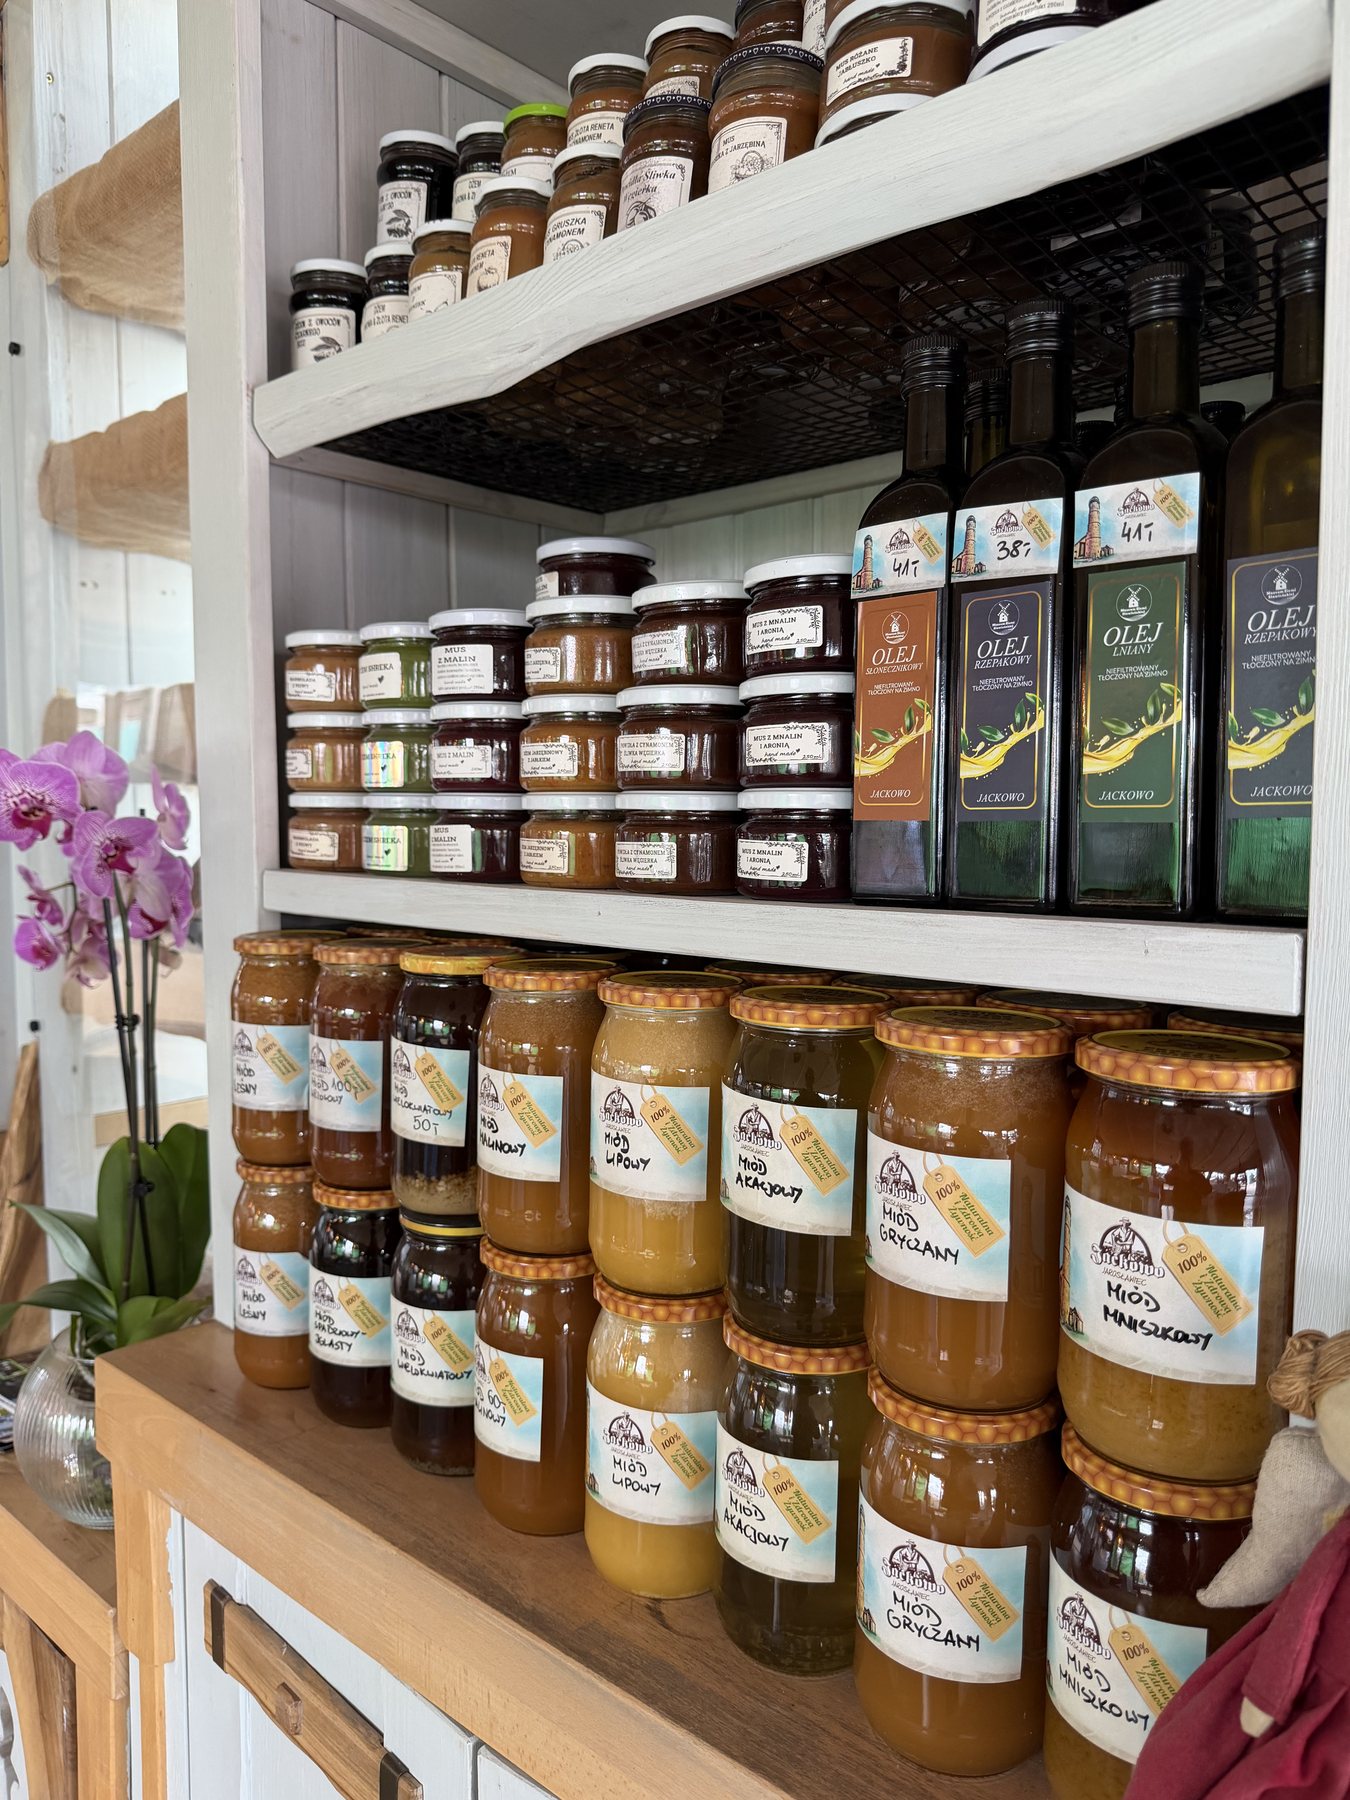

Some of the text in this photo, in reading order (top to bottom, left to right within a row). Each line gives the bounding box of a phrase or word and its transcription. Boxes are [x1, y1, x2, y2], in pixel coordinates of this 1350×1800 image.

[836, 47, 879, 71] MUS RÓŻANE
[837, 56, 876, 78] JABŁUSZKO
[590, 122, 614, 131] RENETA
[723, 136, 735, 147] MUS
[729, 140, 766, 155] JARZĘBINĄ
[644, 168, 676, 183] Śliwka
[552, 217, 587, 232] GRUSZKA
[752, 621, 763, 629] MUS
[768, 617, 797, 626] MNALIN
[1247, 604, 1317, 632] OLEJ
[760, 627, 785, 636] ARONIĄ
[1103, 622, 1164, 647] OLEJ
[1243, 626, 1318, 645] RZEPAKOWY
[444, 646, 466, 654] MUS
[871, 644, 918, 666] OLEJ
[977, 636, 1029, 659] OLEJ
[1112, 643, 1154, 657] LNIANY
[1251, 649, 1312, 663] NIEFILTROWANY
[443, 656, 476, 664] MALIN
[865, 662, 924, 676] SŁONECZNIKOWY
[974, 655, 1033, 670] RZEPAKOWY
[1106, 664, 1159, 675] NIEFILTROWANY
[1242, 656, 1316, 670] TŁOCZONY NA ZIMN
[873, 681, 914, 690] NIEFILTROWANY
[972, 683, 1003, 692] TŁOCZONY
[1012, 680, 1034, 688] ZIMNO
[979, 675, 1026, 686] NIEFILTROWANY
[1097, 669, 1168, 682] TŁOCZONY NA ZIMNO
[867, 688, 895, 696] TŁOCZONY
[870, 789, 912, 799] JACKOWO
[976, 792, 1025, 803] JACKOWO
[1098, 790, 1154, 801] JACKOWO
[1250, 785, 1313, 798] JACKOWO
[749, 857, 772, 865] ARONIĄ
[510, 1093, 527, 1108] 100%
[650, 1105, 671, 1123] 100%
[605, 1131, 630, 1154] MIÓD
[669, 1114, 696, 1149] Naturalna
[733, 1125, 782, 1151] Jackowo
[790, 1127, 813, 1147] 100%
[606, 1150, 651, 1171] LIPOWY
[738, 1153, 767, 1176] MIÓD
[810, 1149, 832, 1179] Zdrowa
[811, 1138, 841, 1176] Naturalna
[736, 1172, 803, 1203] AKACJOWY
[875, 1175, 926, 1205] Jackowo
[935, 1180, 960, 1201] 100%
[883, 1202, 919, 1232] MIÓD
[948, 1206, 979, 1241] Żywność
[958, 1203, 984, 1238] Zdrowa
[960, 1191, 994, 1235] Naturalna
[879, 1223, 959, 1265] GRYCZANY
[1090, 1242, 1165, 1279] Jackowo
[1176, 1250, 1208, 1274] 100%
[242, 1289, 266, 1302] MIÓD
[1107, 1280, 1161, 1313] MIÓD
[1203, 1277, 1232, 1314] Zdrowa
[1207, 1264, 1242, 1312] Naturalna
[1192, 1280, 1223, 1319] Żywność
[239, 1304, 266, 1321] LEŚNY
[431, 1326, 447, 1340] 100%
[1103, 1304, 1213, 1351] MNISZKOWY
[400, 1345, 425, 1366] MIÓD
[495, 1370, 509, 1383] 100%
[661, 1432, 681, 1450] 100%
[613, 1454, 647, 1477] MIÓD
[680, 1442, 705, 1473] Naturalna
[612, 1473, 662, 1496] LIPOWY
[773, 1478, 795, 1495] 100%
[729, 1490, 766, 1521] MIÓD
[783, 1500, 809, 1532] Żywność
[792, 1499, 814, 1529] Zdrowa
[793, 1488, 822, 1526] Naturalna
[723, 1507, 789, 1552] AKACJOWY
[882, 1556, 946, 1595] Jackowo
[956, 1570, 981, 1592] 100%
[892, 1591, 942, 1627] MIÓD
[968, 1595, 995, 1629] Żywność
[978, 1592, 1002, 1624] Zdrowa
[980, 1581, 1010, 1621] Naturalna
[887, 1609, 980, 1652] GRYCZANY
[1121, 1642, 1150, 1661] 100%
[1066, 1646, 1111, 1693] MIÓD
[1059, 1664, 1150, 1731] MNISZKOWY
